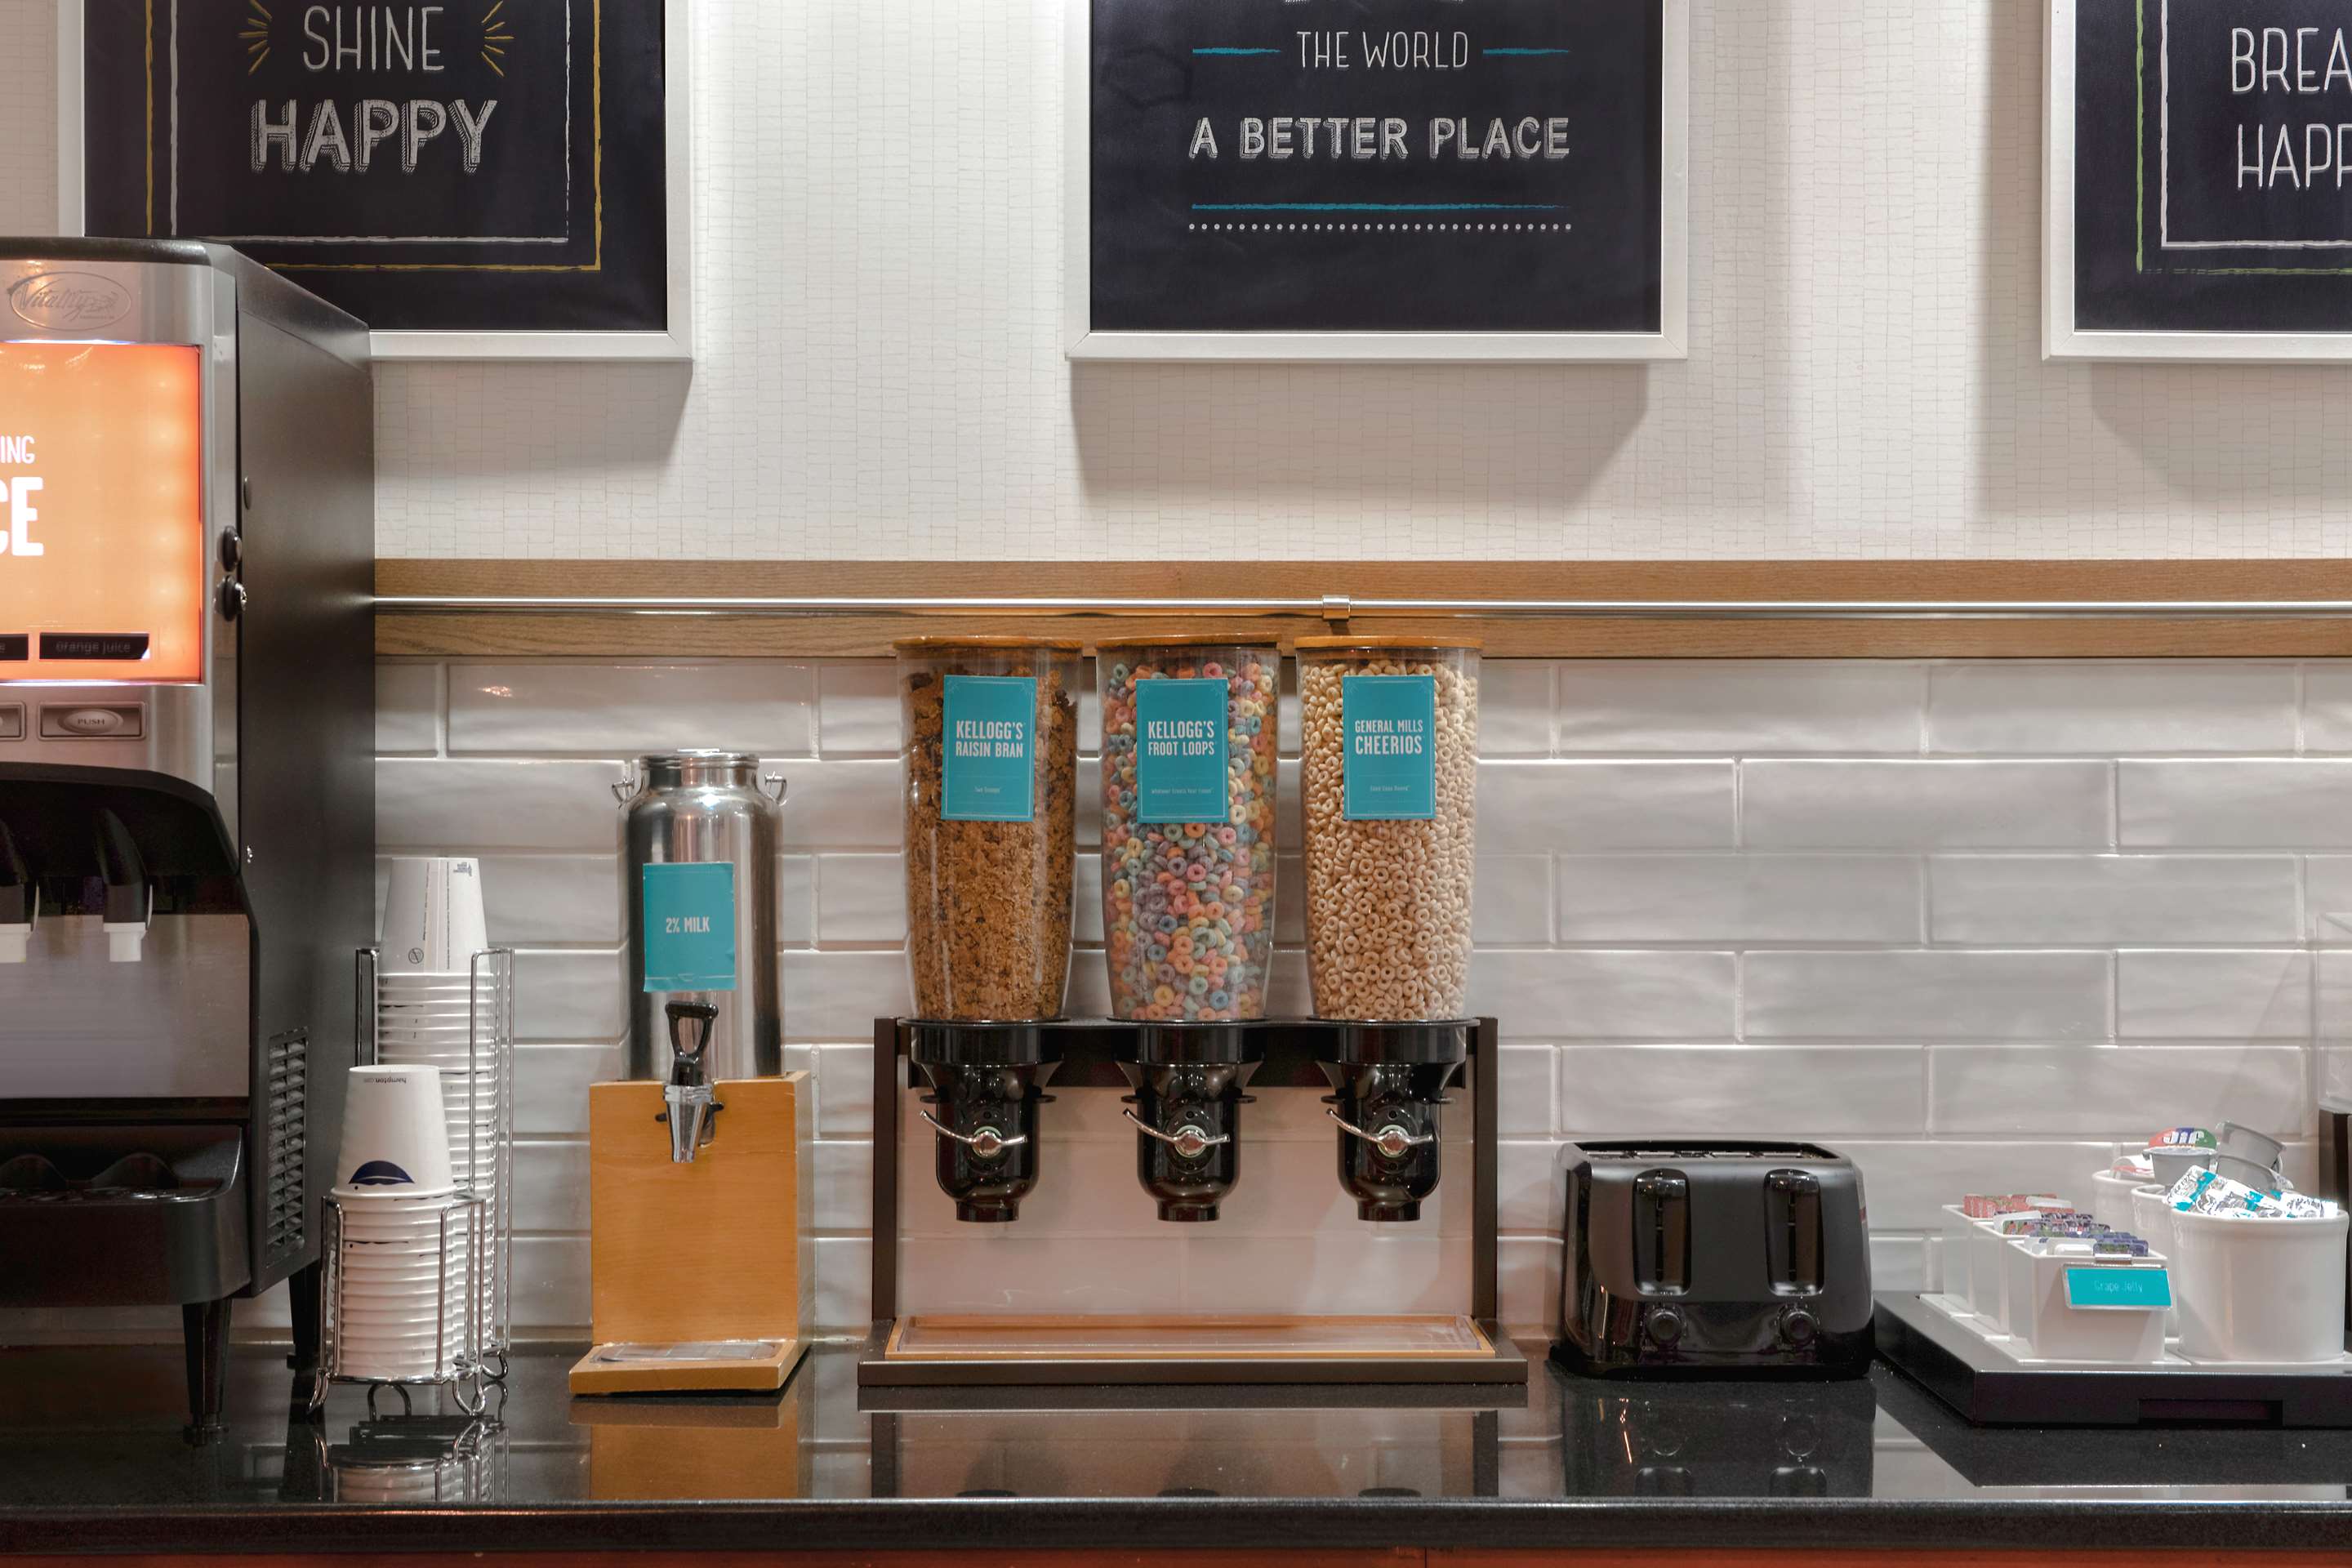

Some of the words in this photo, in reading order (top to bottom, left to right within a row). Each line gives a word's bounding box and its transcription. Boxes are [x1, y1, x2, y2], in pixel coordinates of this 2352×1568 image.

[302, 6, 445, 74] SHINE
[1296, 30, 1350, 69] THE
[1361, 30, 1470, 70] WORLD
[2231, 27, 2352, 93] BREA
[251, 98, 497, 173] HAPPY
[1188, 117, 1218, 158] A
[1239, 117, 1409, 159] BETTER
[1429, 117, 1570, 159] PLACE
[0, 435, 35, 464] ING
[0, 476, 44, 556] E
[56, 641, 100, 655] orange
[103, 641, 131, 654] juice
[956, 719, 1023, 741] KELLOGG'S
[1148, 720, 1215, 739] KELLOGG'S
[1355, 719, 1394, 733] GENERAL
[1397, 719, 1423, 733] MILLS
[956, 741, 991, 757] RAISIN
[995, 742, 1024, 758] BRAN
[1148, 742, 1178, 756] FROOT
[1183, 741, 1215, 756] LOOPS
[1355, 736, 1423, 755] CHEERIOS
[666, 917, 680, 933] 2%
[684, 916, 710, 933] MILK
[2094, 1280, 2120, 1294] Grape
